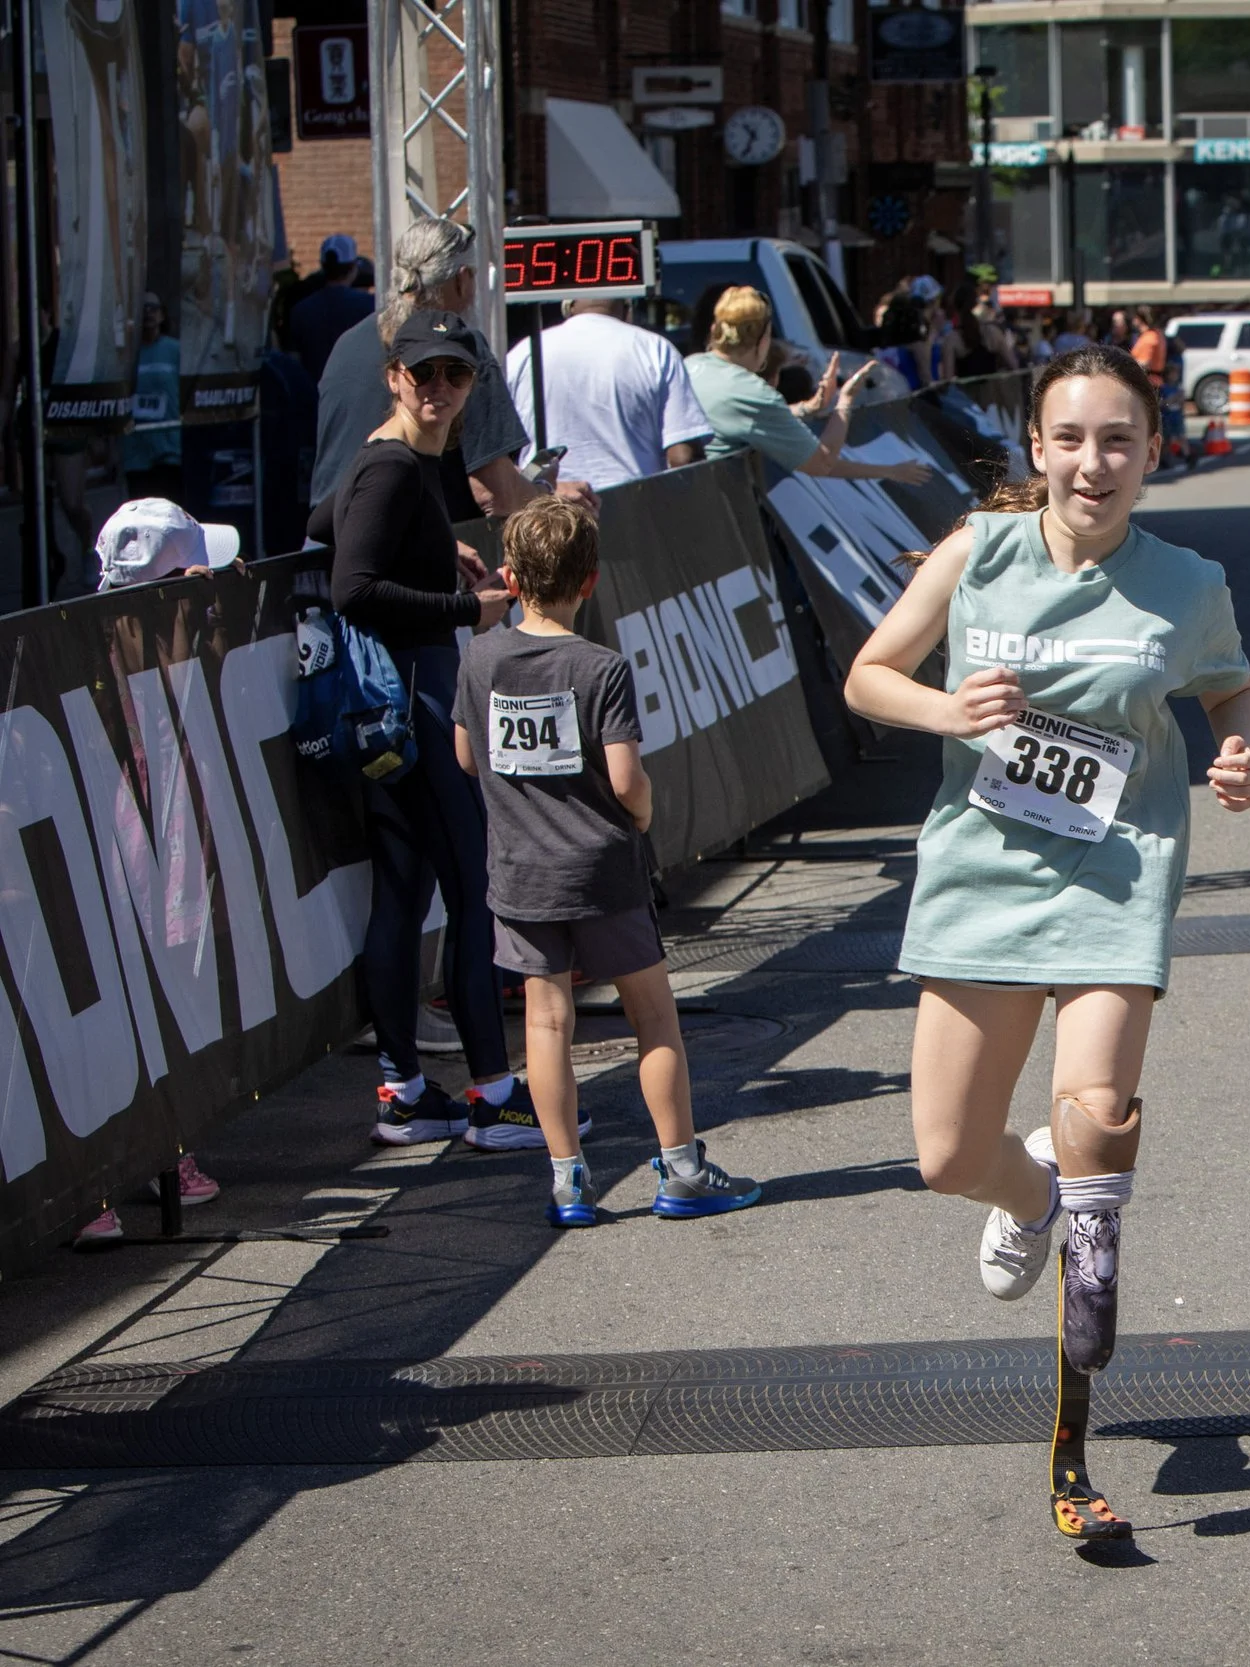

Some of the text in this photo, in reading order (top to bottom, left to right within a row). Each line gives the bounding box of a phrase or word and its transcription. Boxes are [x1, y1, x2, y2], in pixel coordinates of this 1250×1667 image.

[47, 399, 116, 418] DISABILITY
[615, 564, 799, 757] BIONIC
[966, 627, 1139, 663] BIONIC
[494, 696, 552, 711] BIONIC
[499, 715, 560, 751] 294
[1016, 709, 1104, 750] BIONIC
[554, 763, 577, 771] DRINK
[1005, 735, 1101, 805] 338
[979, 794, 1097, 837] FOOD DRINK DRINK
[498, 1108, 534, 1126] HOKA
